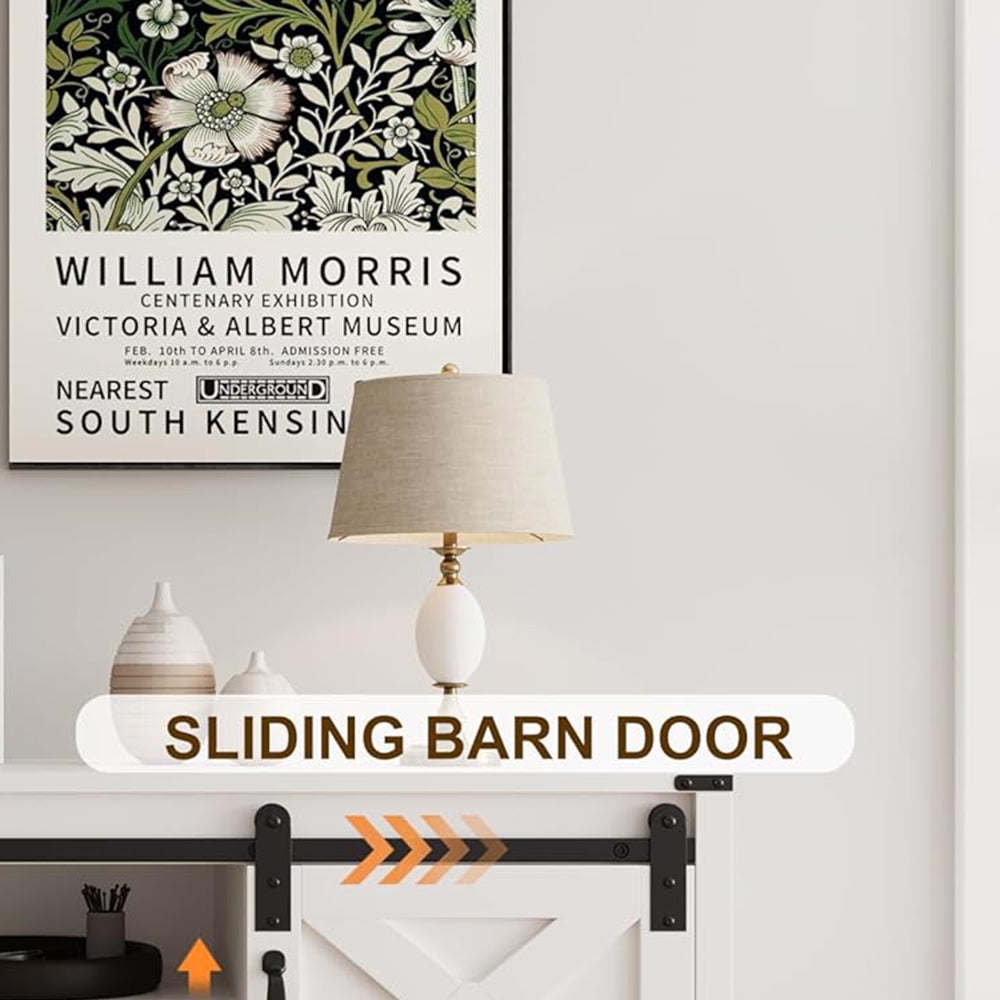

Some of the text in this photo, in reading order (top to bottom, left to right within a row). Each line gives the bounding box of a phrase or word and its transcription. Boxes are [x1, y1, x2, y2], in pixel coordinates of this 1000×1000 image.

[55, 255, 462, 287] WILLIAM MORRIS
[140, 292, 374, 309] CENTENARY EXHIBITION
[56, 315, 462, 337] VICTORIA & ALBERT MUSEUM
[124, 345, 384, 356] FEB. 10th TO APRIL 8th. ADMISSION FREE
[269, 359, 306, 368] Sundays
[56, 379, 170, 401] NEAREST
[56, 409, 346, 436] SOUTH KENSIN
